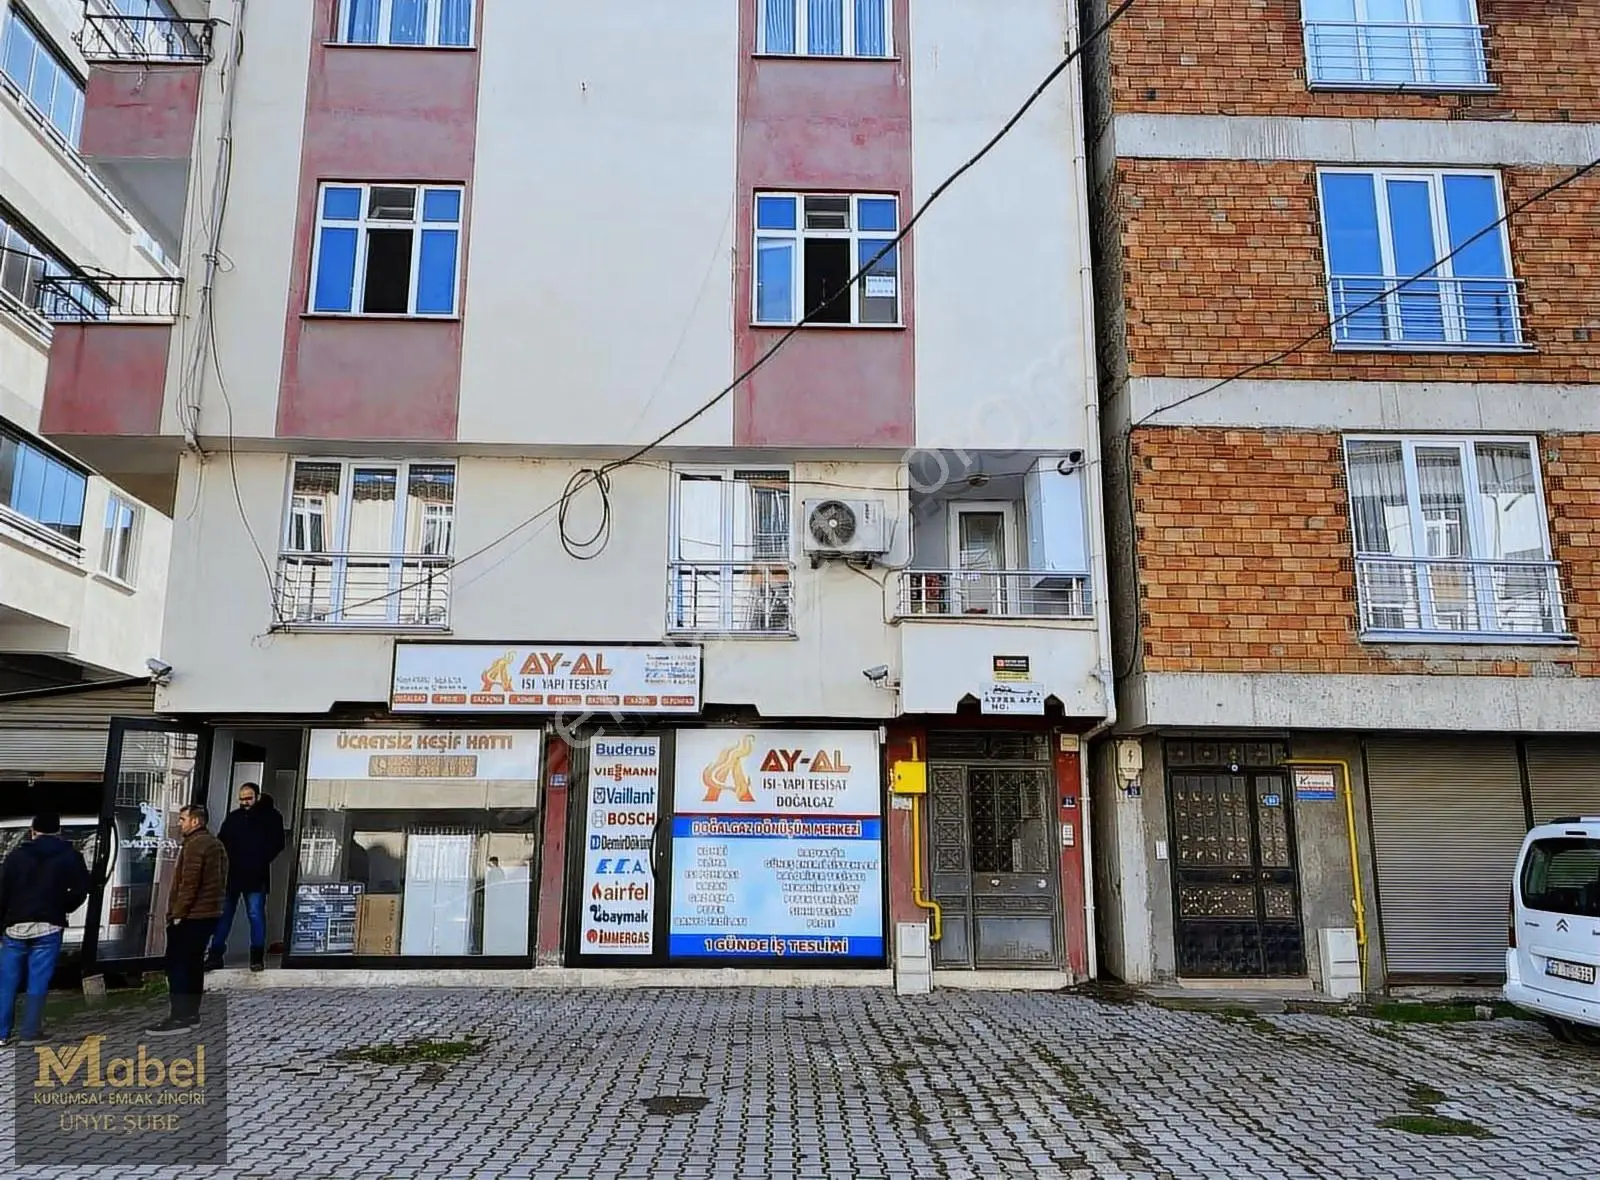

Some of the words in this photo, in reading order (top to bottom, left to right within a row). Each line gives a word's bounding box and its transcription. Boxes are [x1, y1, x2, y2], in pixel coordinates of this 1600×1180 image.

[520, 652, 613, 675] AY-AL
[542, 678, 565, 689] YAPI
[567, 676, 609, 690] TESİSAT
[337, 731, 412, 749] ÜCRETSİZ
[416, 731, 462, 753] KEŞİF
[466, 734, 513, 750] HATTI
[595, 743, 656, 756] Buderus
[760, 749, 851, 773] AY-AL
[809, 776, 848, 791] TESİSAT
[606, 787, 655, 804] Vaillant
[776, 794, 834, 808] DOĞALGAZ
[607, 812, 656, 826] BOSCH
[692, 818, 754, 836] DOĞALGAZ
[755, 818, 813, 839] DÖNÜŞÜM
[814, 820, 862, 836] MERKEZİ
[604, 881, 648, 900] airfel
[602, 909, 648, 925] baymak
[712, 935, 769, 953] GÜNDE
[771, 936, 785, 955] İŞ
[789, 936, 849, 954] TESLİMİ
